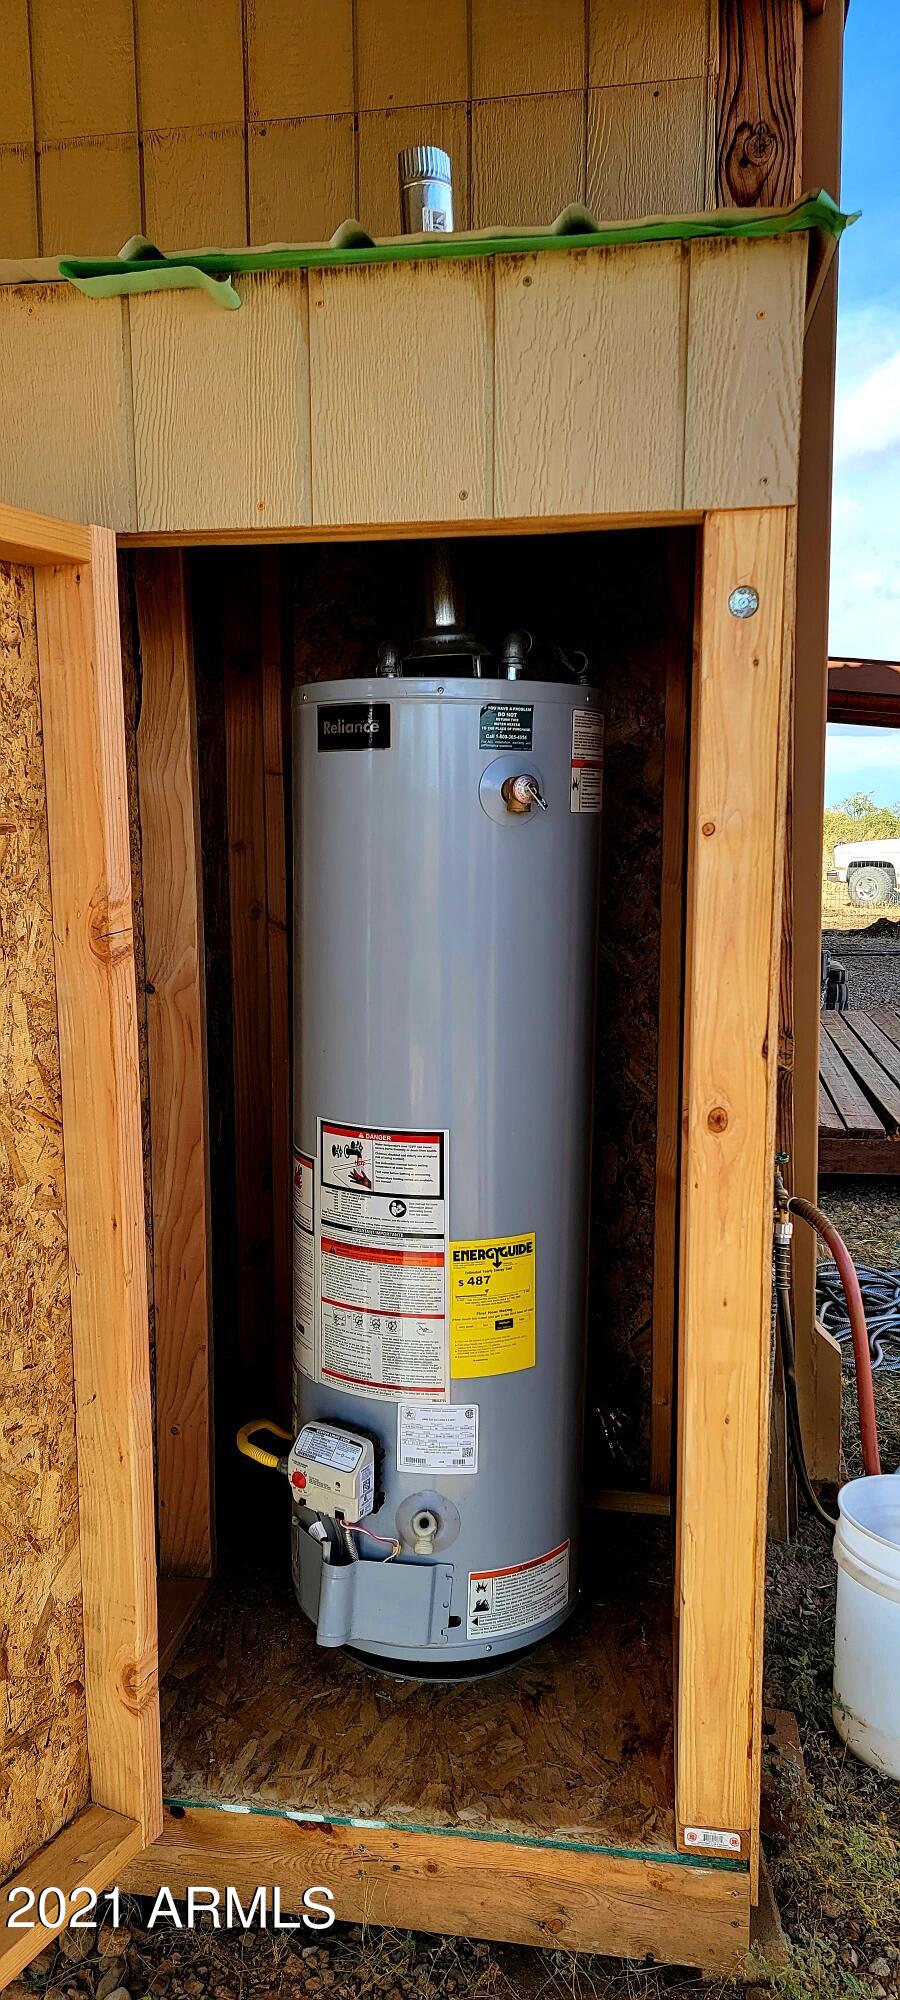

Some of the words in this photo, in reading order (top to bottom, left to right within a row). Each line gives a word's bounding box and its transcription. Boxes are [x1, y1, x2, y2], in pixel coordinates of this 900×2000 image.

[324, 719, 379, 734] Reliance
[366, 1133, 391, 1141] DANGER
[453, 1242, 533, 1264] ENERGYGUIDE
[467, 1276, 491, 1286] 487
